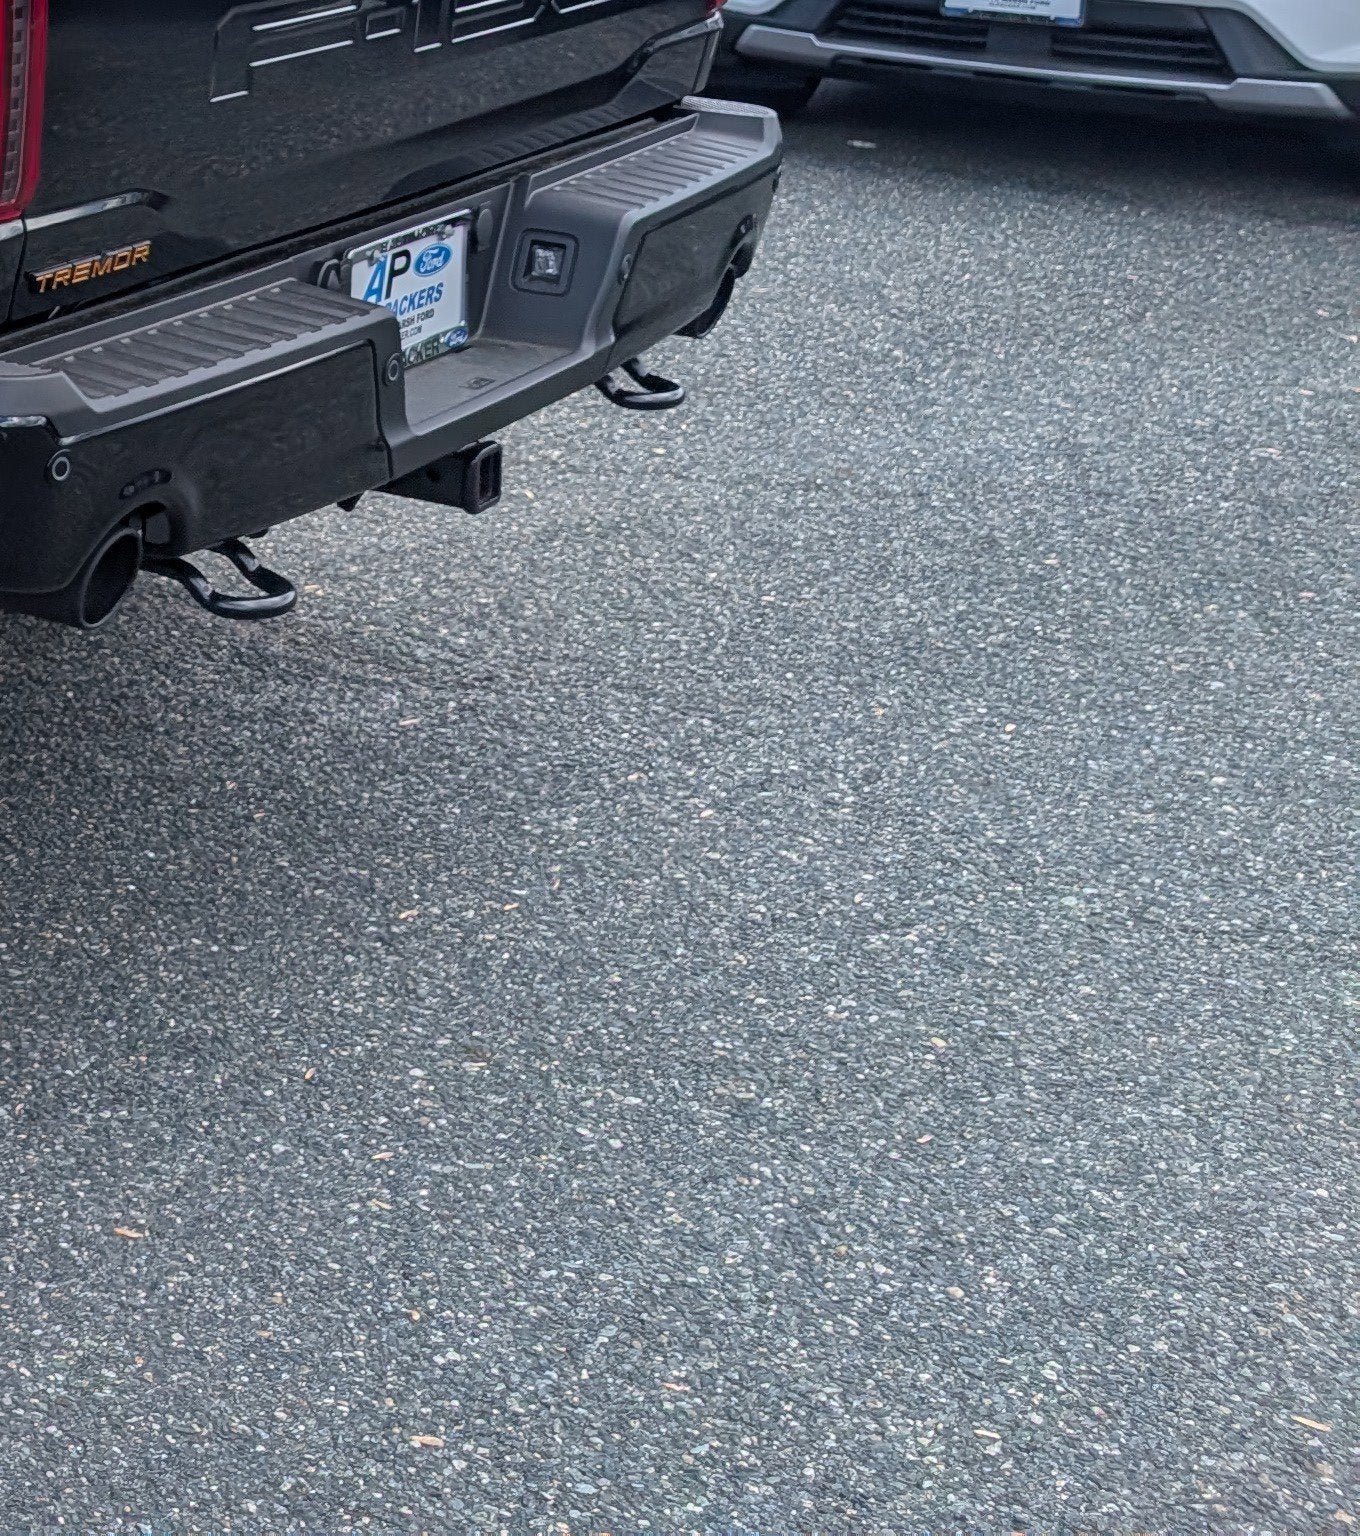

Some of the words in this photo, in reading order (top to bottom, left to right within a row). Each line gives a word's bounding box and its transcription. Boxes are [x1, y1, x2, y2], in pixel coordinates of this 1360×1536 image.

[36, 245, 150, 293] TREMOR
[363, 249, 412, 304] AP
[419, 247, 447, 273] Ford
[416, 308, 435, 323] FORD
